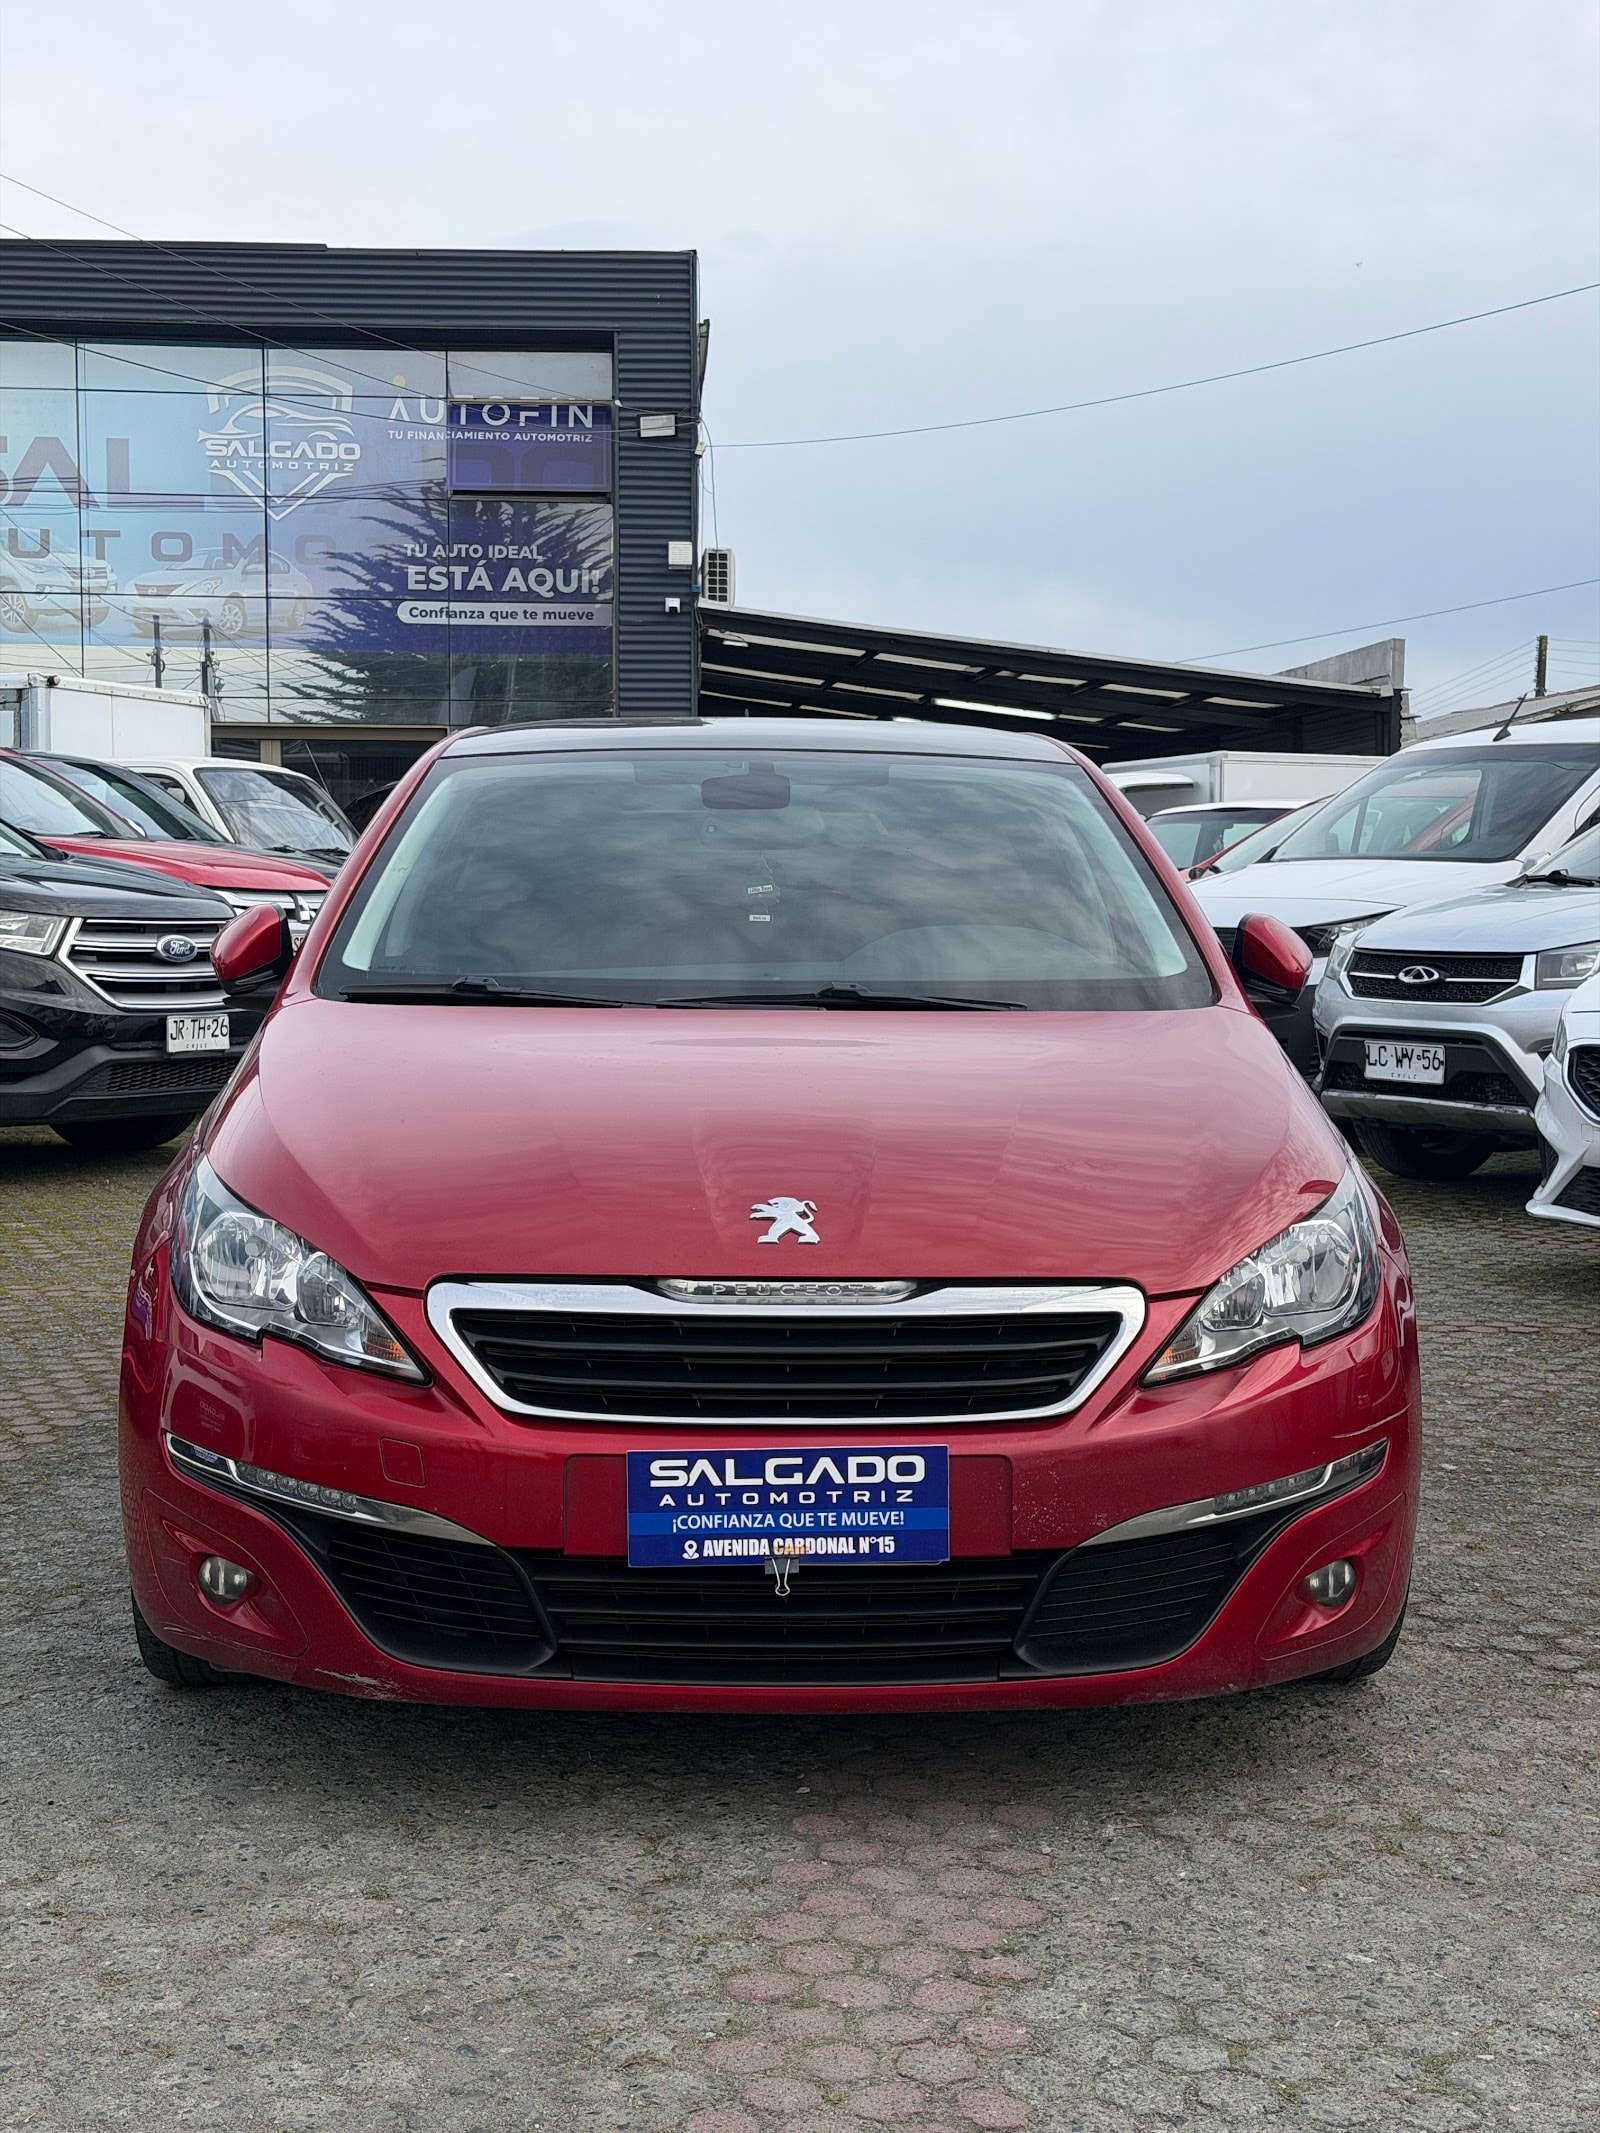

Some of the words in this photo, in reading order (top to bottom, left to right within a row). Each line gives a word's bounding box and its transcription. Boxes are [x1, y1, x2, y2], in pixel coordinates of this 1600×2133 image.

[388, 395, 593, 429] AUTOFIN
[388, 430, 403, 439] TU
[407, 431, 510, 441] FINANCIAMIENTO
[514, 432, 593, 443] AUTOMOTRIZ
[205, 440, 361, 460] SALGADO
[210, 459, 354, 471] AUTOMOTRIZ
[404, 543, 427, 557] TU
[432, 544, 483, 559] AUTO
[488, 545, 543, 560] IDEAL
[407, 560, 493, 592] ESTÁ
[409, 606, 485, 620] Confianza
[489, 609, 518, 622] que
[522, 609, 538, 620] te
[543, 610, 595, 621] mueve
[169, 940, 191, 955] Ford
[712, 1284, 864, 1296] PEUGEOT
[650, 1455, 925, 1487] SALGADO
[659, 1490, 913, 1507] AUTOMOTRIZ
[672, 1513, 775, 1533] ¡CONFIANZA
[779, 1513, 814, 1528] QUE
[817, 1512, 837, 1527] TE
[841, 1511, 904, 1526] MUEVE!
[703, 1539, 769, 1557] AVENIDA
[773, 1537, 855, 1556] CARDONAL
